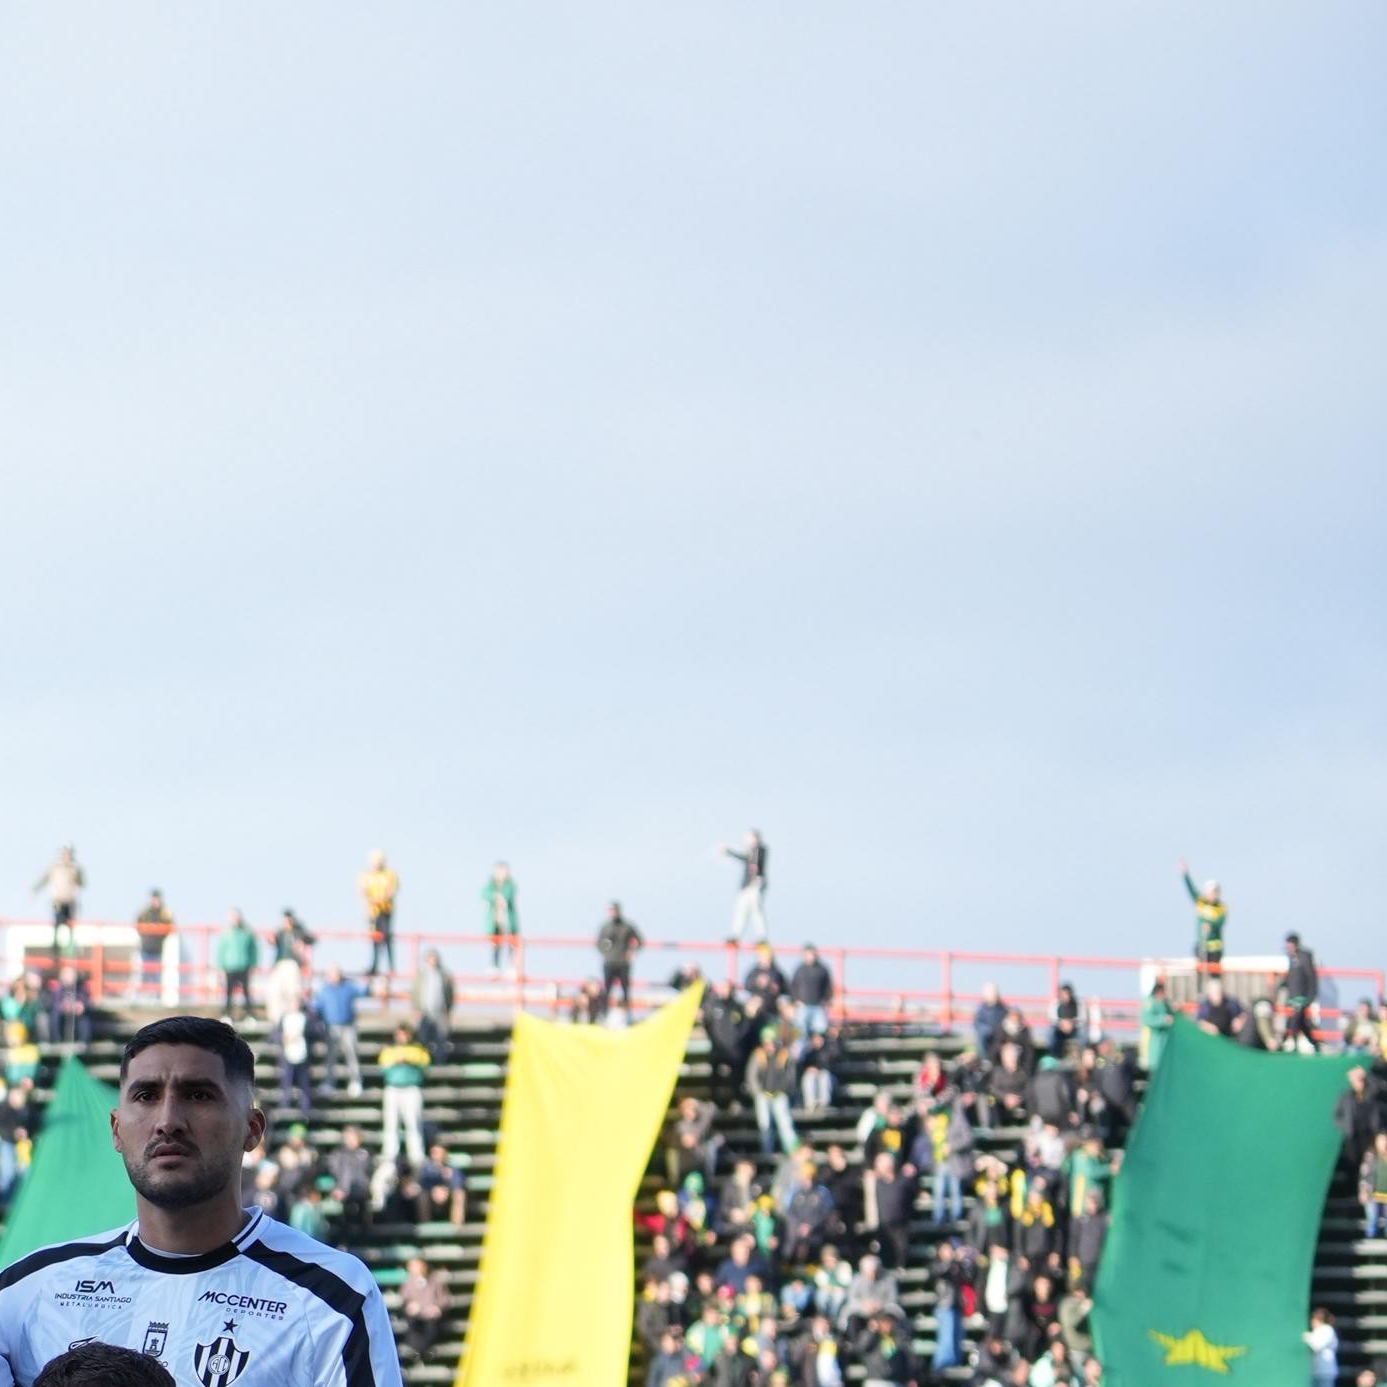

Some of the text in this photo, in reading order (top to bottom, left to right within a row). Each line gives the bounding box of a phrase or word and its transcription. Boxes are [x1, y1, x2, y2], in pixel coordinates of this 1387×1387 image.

[75, 1280, 115, 1294] ISM
[54, 1293, 132, 1303] INDUSTRIA SANTIAGO
[198, 1291, 287, 1314] MCCENTER
[226, 1307, 284, 1320] DEPORTES
